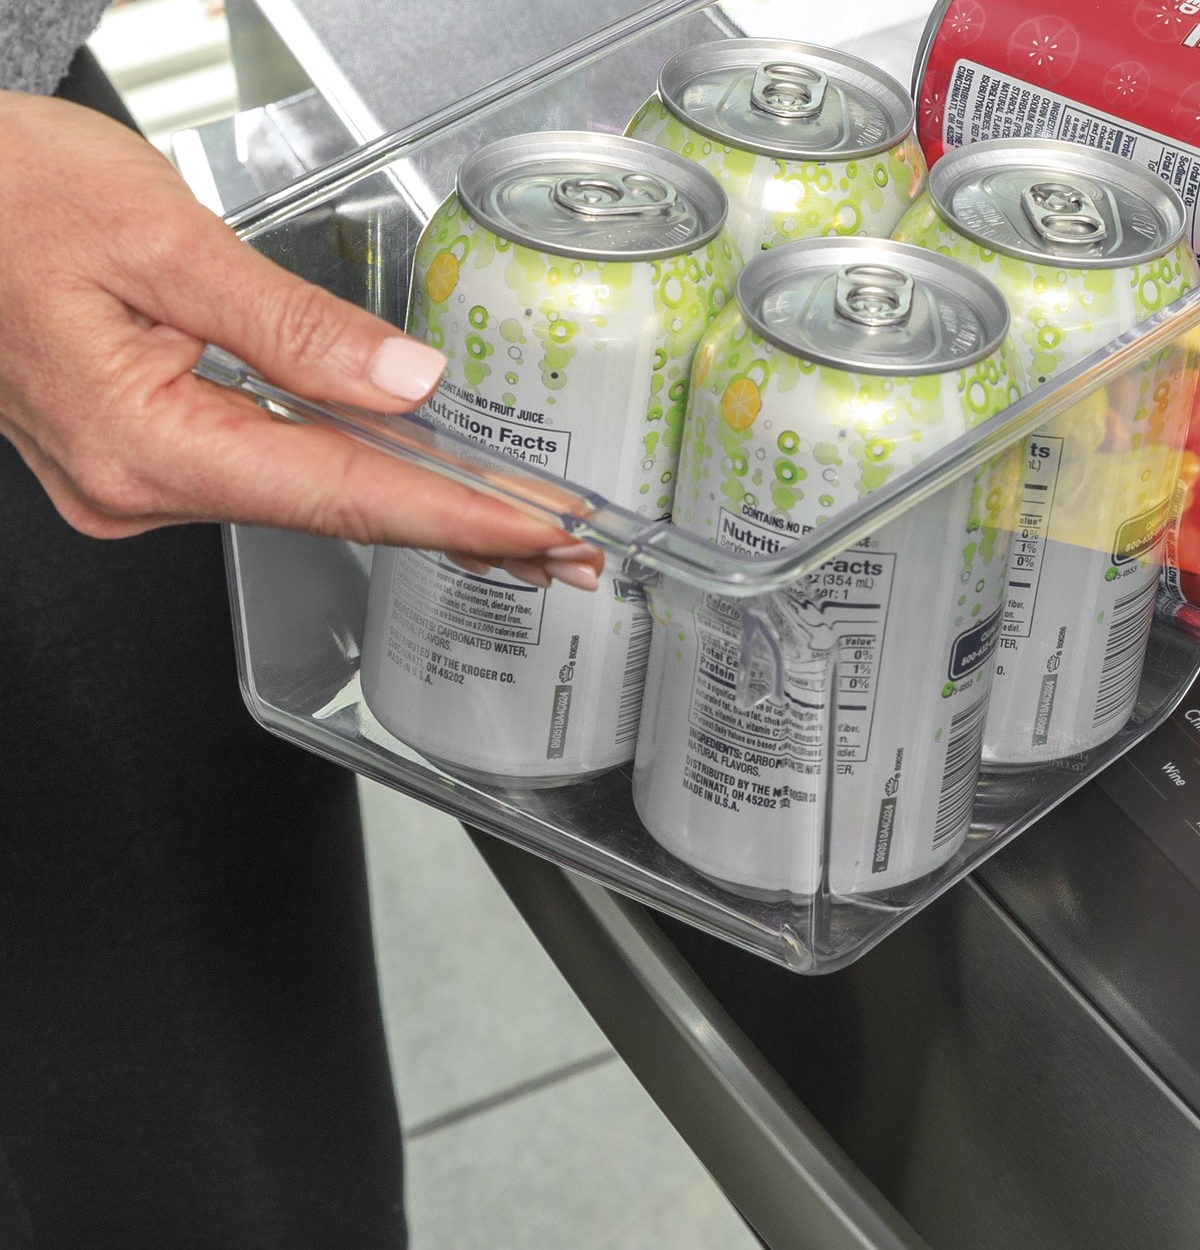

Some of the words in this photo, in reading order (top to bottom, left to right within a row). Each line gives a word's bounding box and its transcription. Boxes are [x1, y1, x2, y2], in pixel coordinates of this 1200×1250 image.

[956, 68, 975, 119] DISTRIBUTED
[995, 81, 1011, 113] NATURAL
[1005, 85, 1021, 115] STARCH,
[1015, 90, 1031, 122] SORBATE
[1027, 93, 1041, 122] SODIUM
[1039, 97, 1051, 116] CORN
[947, 112, 956, 124] OH
[956, 119, 964, 131] BY
[1091, 121, 1100, 135] and
[971, 122, 980, 138] RED
[1108, 128, 1117, 141] Not
[1162, 151, 1176, 173] Total
[1174, 155, 1190, 186] Sodium
[1187, 184, 1198, 197] Fat
[438, 378, 475, 404] CONTAINS
[476, 395, 488, 410] NO
[489, 401, 516, 418] FRUIT
[517, 409, 544, 425] JUICE
[499, 427, 558, 453] Facts
[528, 452, 549, 467] mL)
[742, 504, 785, 530] CONTAINS
[786, 521, 800, 534] NO
[1021, 528, 1039, 540] 0%
[1020, 542, 1037, 554] 1%
[1016, 556, 1034, 568] 0%
[823, 573, 852, 587] (354
[855, 577, 874, 590] mL)
[1167, 566, 1176, 584] LOW
[456, 579, 463, 588] of
[463, 581, 488, 596] calories
[489, 588, 504, 599] from
[504, 591, 516, 602] fat,
[454, 590, 490, 609] cholesterol,
[491, 600, 514, 613] dietary
[515, 604, 532, 616] fiber,
[1007, 600, 1024, 610] fiber,
[448, 611, 465, 626] based
[465, 619, 473, 627] on
[477, 622, 494, 634] 2,000
[495, 626, 515, 638] calorie
[515, 630, 529, 640] diet.
[469, 606, 494, 619] calcium
[494, 613, 507, 622] and
[507, 614, 522, 625] iron.
[417, 630, 452, 651] FLAVORS.
[437, 625, 492, 651] CARBONATED
[494, 641, 528, 658] WATER,
[854, 649, 873, 660] 0%
[403, 662, 411, 673] IN
[412, 667, 433, 686] U.S.A.
[426, 662, 438, 675] OH
[438, 667, 465, 685] 45202
[431, 651, 442, 664] BY
[443, 656, 460, 671] THE
[461, 663, 498, 681] KROGER
[499, 672, 516, 685] CO.
[700, 656, 736, 682] Protein
[854, 664, 872, 676] 1%
[849, 678, 869, 689] 0%
[715, 710, 737, 726] vitamin
[737, 718, 744, 730] A,
[746, 722, 771, 736] vitamin
[688, 726, 742, 760] INGREDIENTS:
[728, 729, 746, 743] Values
[746, 737, 756, 746] are
[756, 738, 777, 751] based
[687, 738, 720, 763] NATURAL
[720, 756, 761, 778] FLAVORS.
[685, 755, 735, 787] DISTRIBUTED
[737, 779, 750, 791] BY
[751, 782, 771, 796] THE
[1161, 761, 1186, 787] Wine
[682, 778, 704, 799] MADE
[704, 791, 713, 802] IN
[714, 794, 740, 813] U.S.A.
[684, 766, 730, 797] CINCINNATI,
[731, 790, 744, 802] OH
[745, 793, 777, 809] 45202
